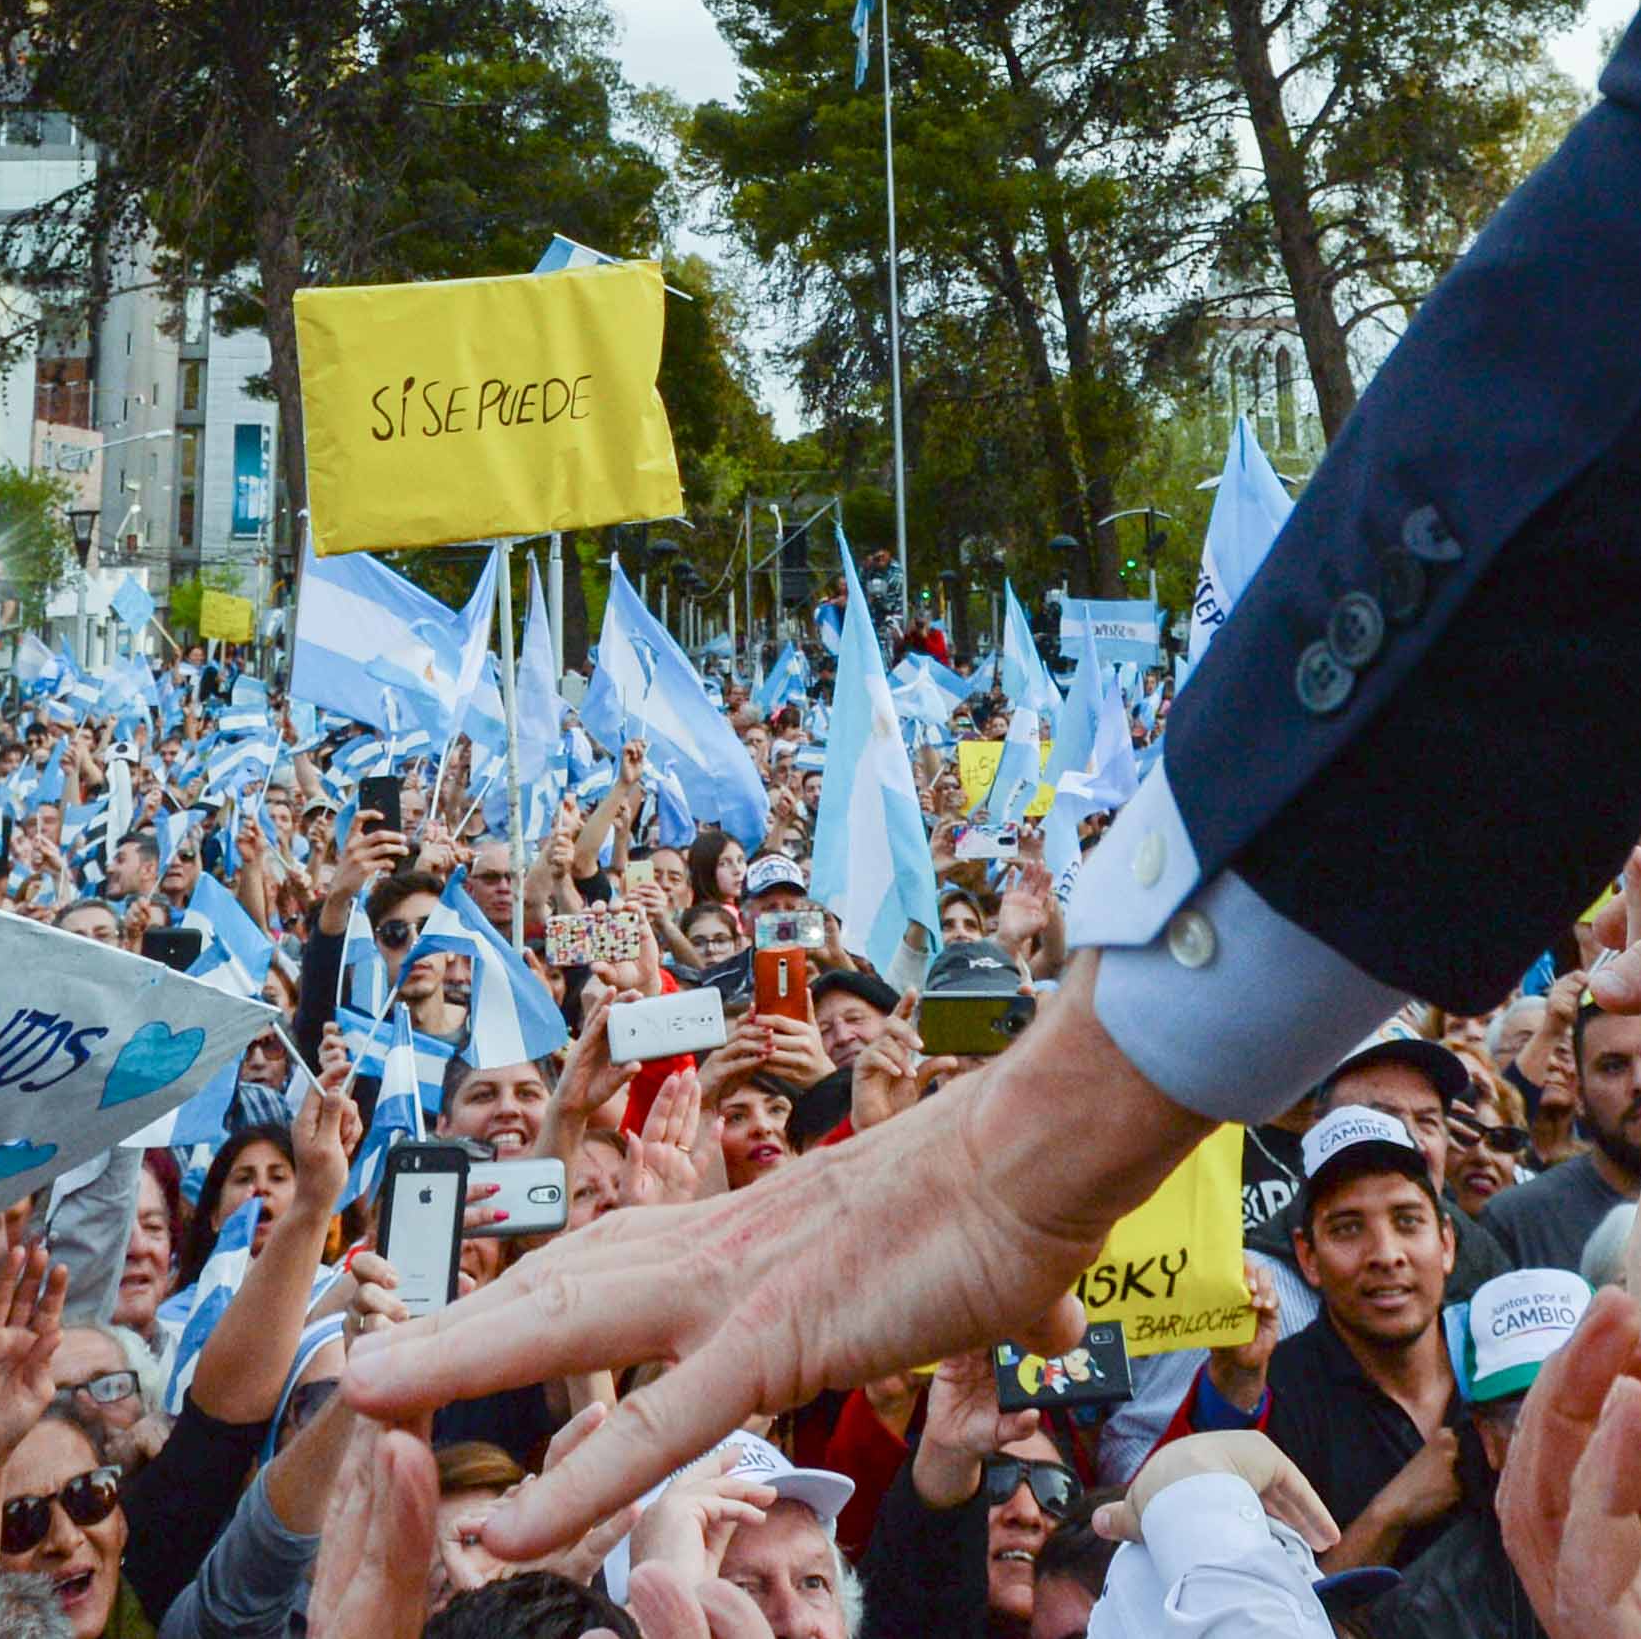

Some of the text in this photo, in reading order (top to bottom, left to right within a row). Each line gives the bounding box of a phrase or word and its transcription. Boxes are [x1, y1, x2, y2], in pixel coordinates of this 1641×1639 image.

[422, 380, 470, 437] SE
[477, 374, 592, 431] PUEDE
[1320, 1124, 1392, 1153] CAMBIO
[1127, 1304, 1252, 1342] BARILOCHE
[1492, 1306, 1576, 1337] CAMBIO
